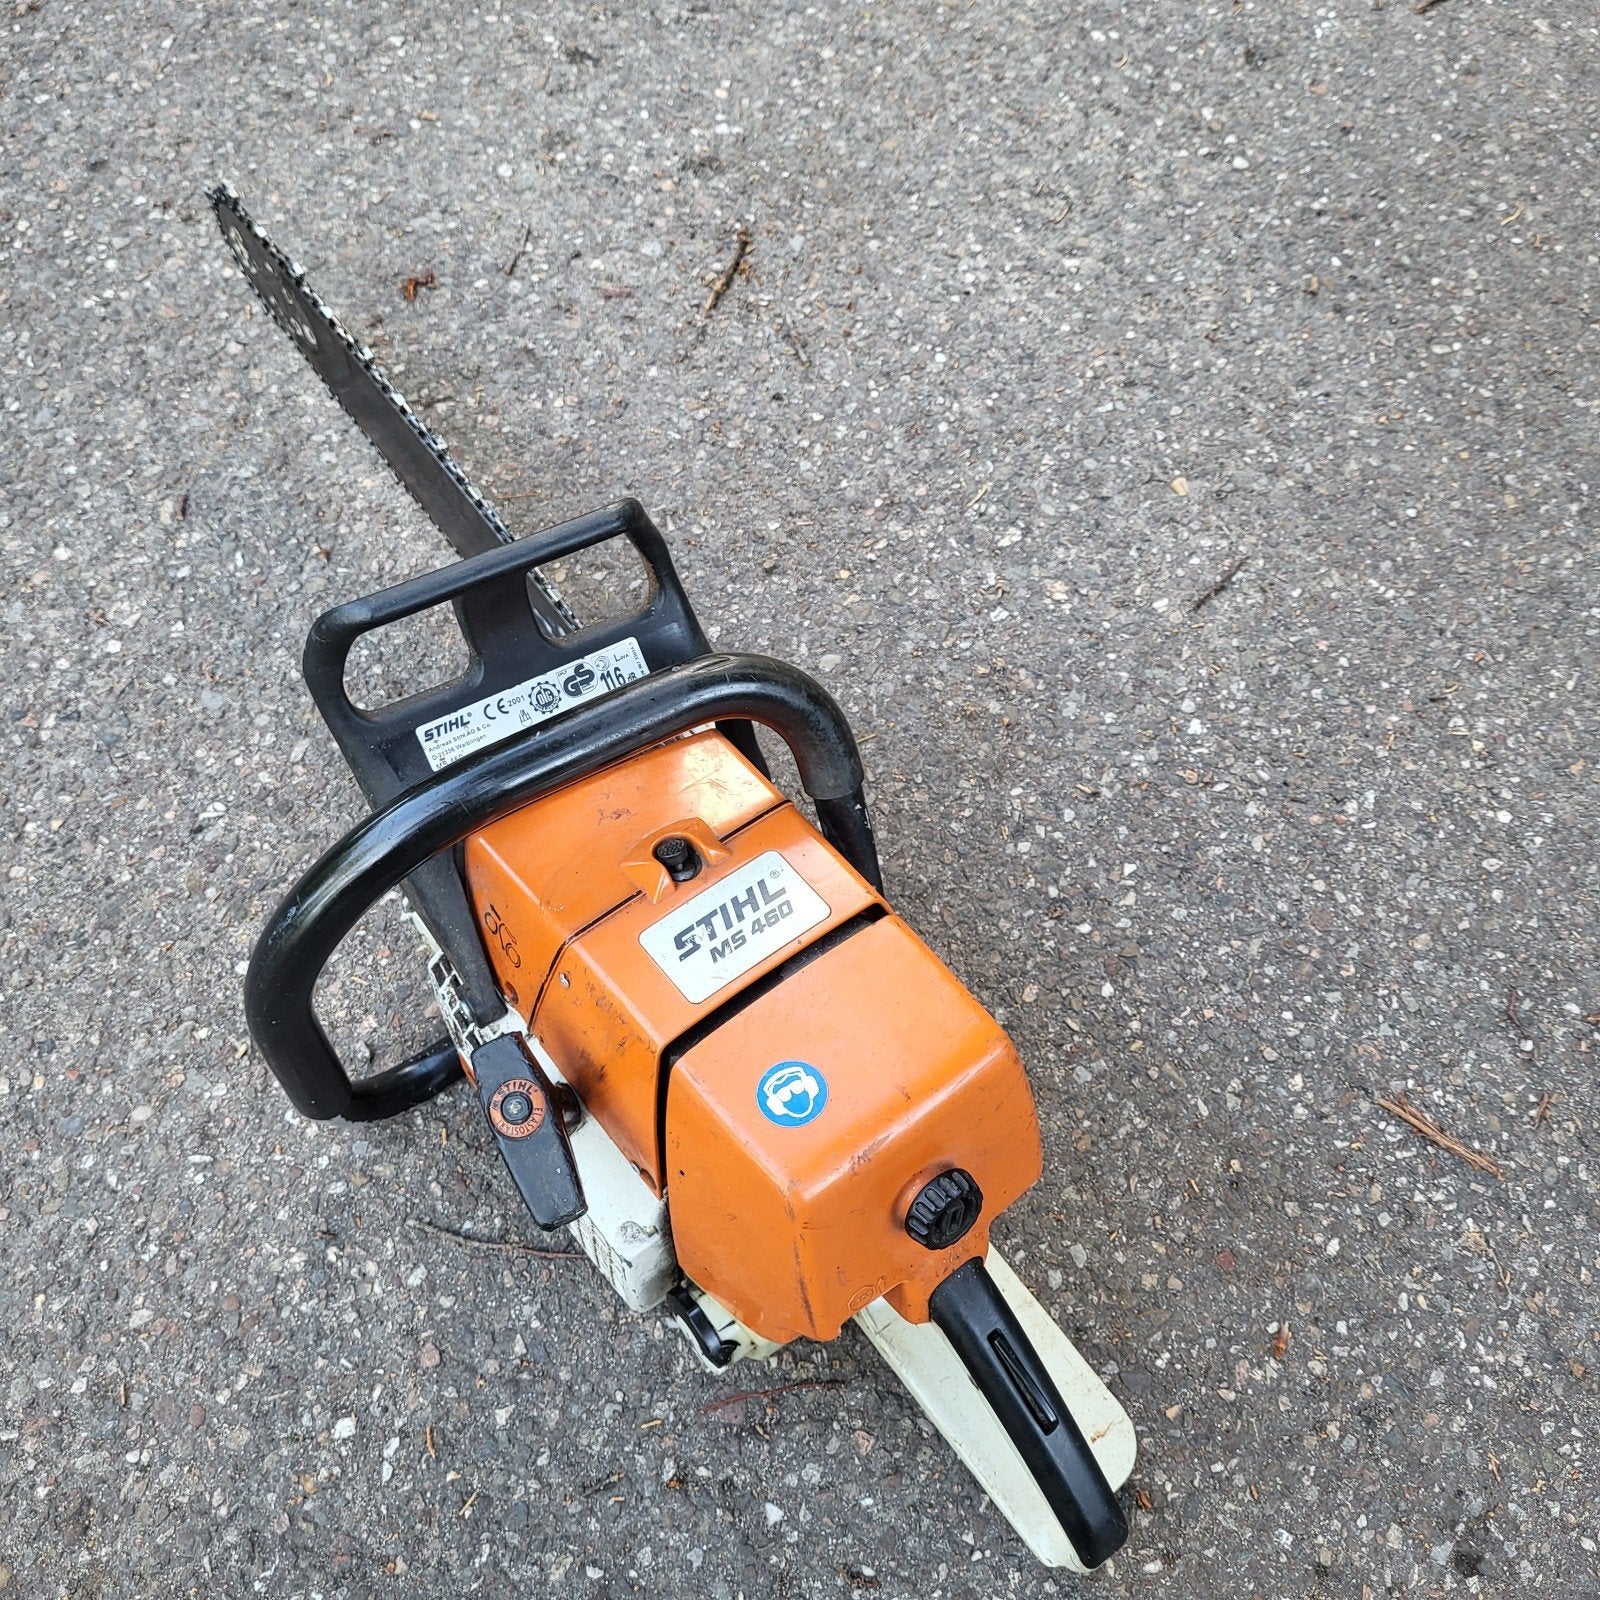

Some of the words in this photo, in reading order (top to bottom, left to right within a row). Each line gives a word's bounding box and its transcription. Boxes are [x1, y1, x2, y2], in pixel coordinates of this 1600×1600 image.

[563, 663, 595, 697] GS
[600, 666, 626, 690] 116
[483, 698, 509, 720] CE
[507, 695, 525, 707] 2001
[424, 715, 470, 742] STIHL
[673, 878, 786, 962] STIHL
[709, 929, 747, 964] MS
[751, 899, 794, 935] 460
